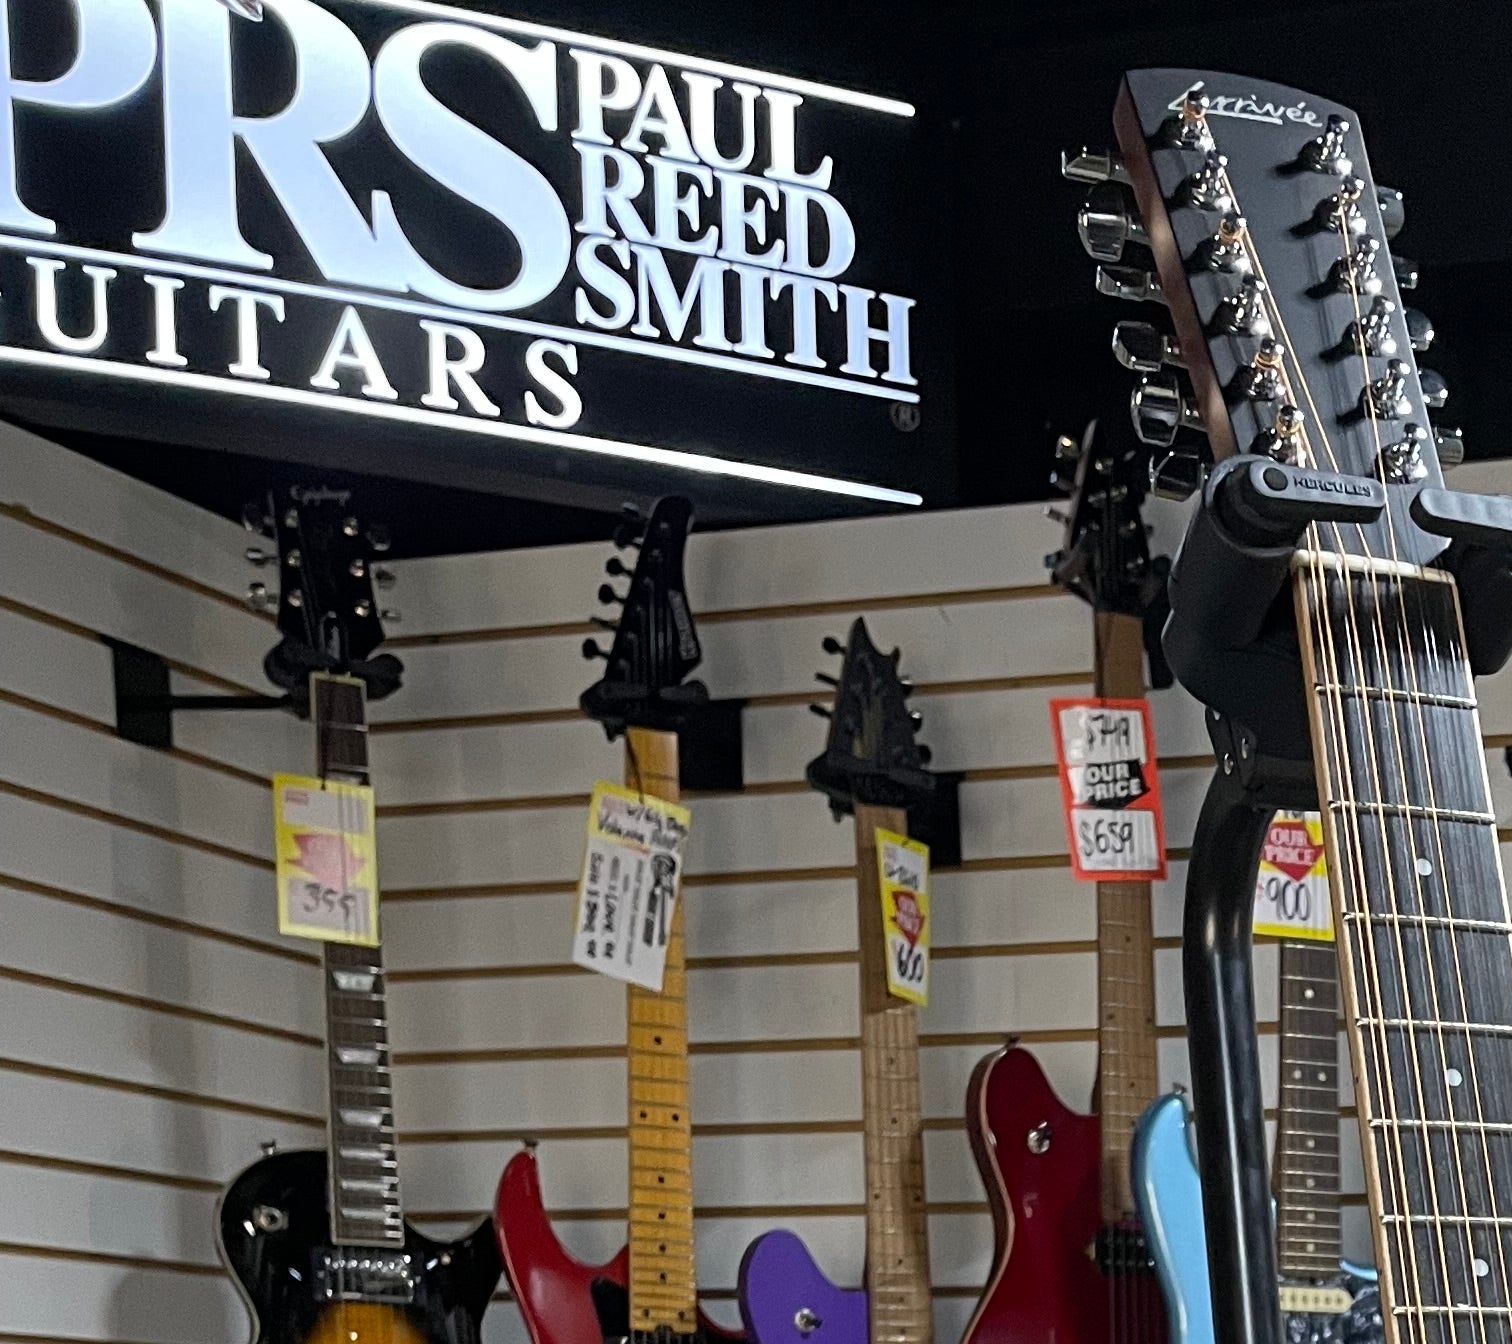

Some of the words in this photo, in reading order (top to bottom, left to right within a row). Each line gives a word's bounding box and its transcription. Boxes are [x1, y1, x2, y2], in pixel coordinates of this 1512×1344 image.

[0, 0, 571, 310] PRS
[569, 48, 833, 190] PAUL
[1168, 81, 1323, 127] Lrrivée
[572, 139, 856, 279] REED
[26, 256, 583, 428] UITARS
[575, 235, 918, 386] SMITH
[1085, 763, 1130, 784] OUR
[1085, 778, 1143, 801] PRICE
[1270, 828, 1308, 846] OUR
